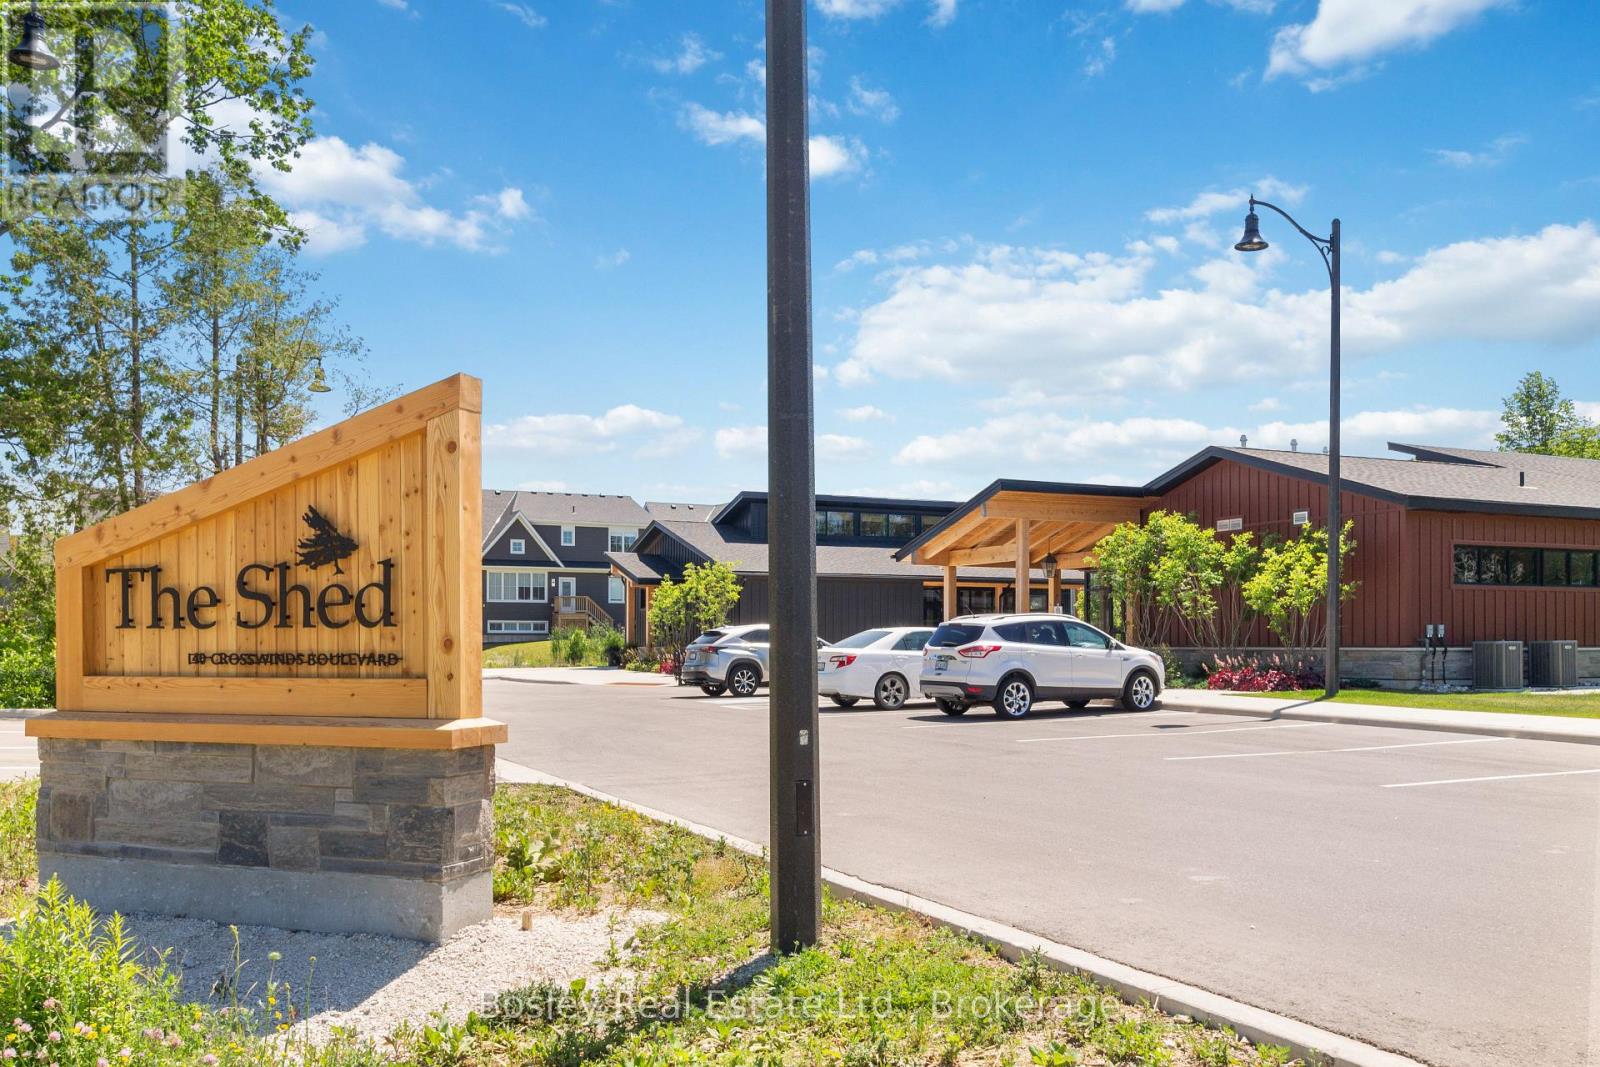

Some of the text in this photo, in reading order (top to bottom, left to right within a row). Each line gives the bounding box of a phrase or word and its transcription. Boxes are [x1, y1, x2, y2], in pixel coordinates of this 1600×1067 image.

[105, 557, 398, 630] The Shed
[307, 652, 400, 667] BOULEVARD
